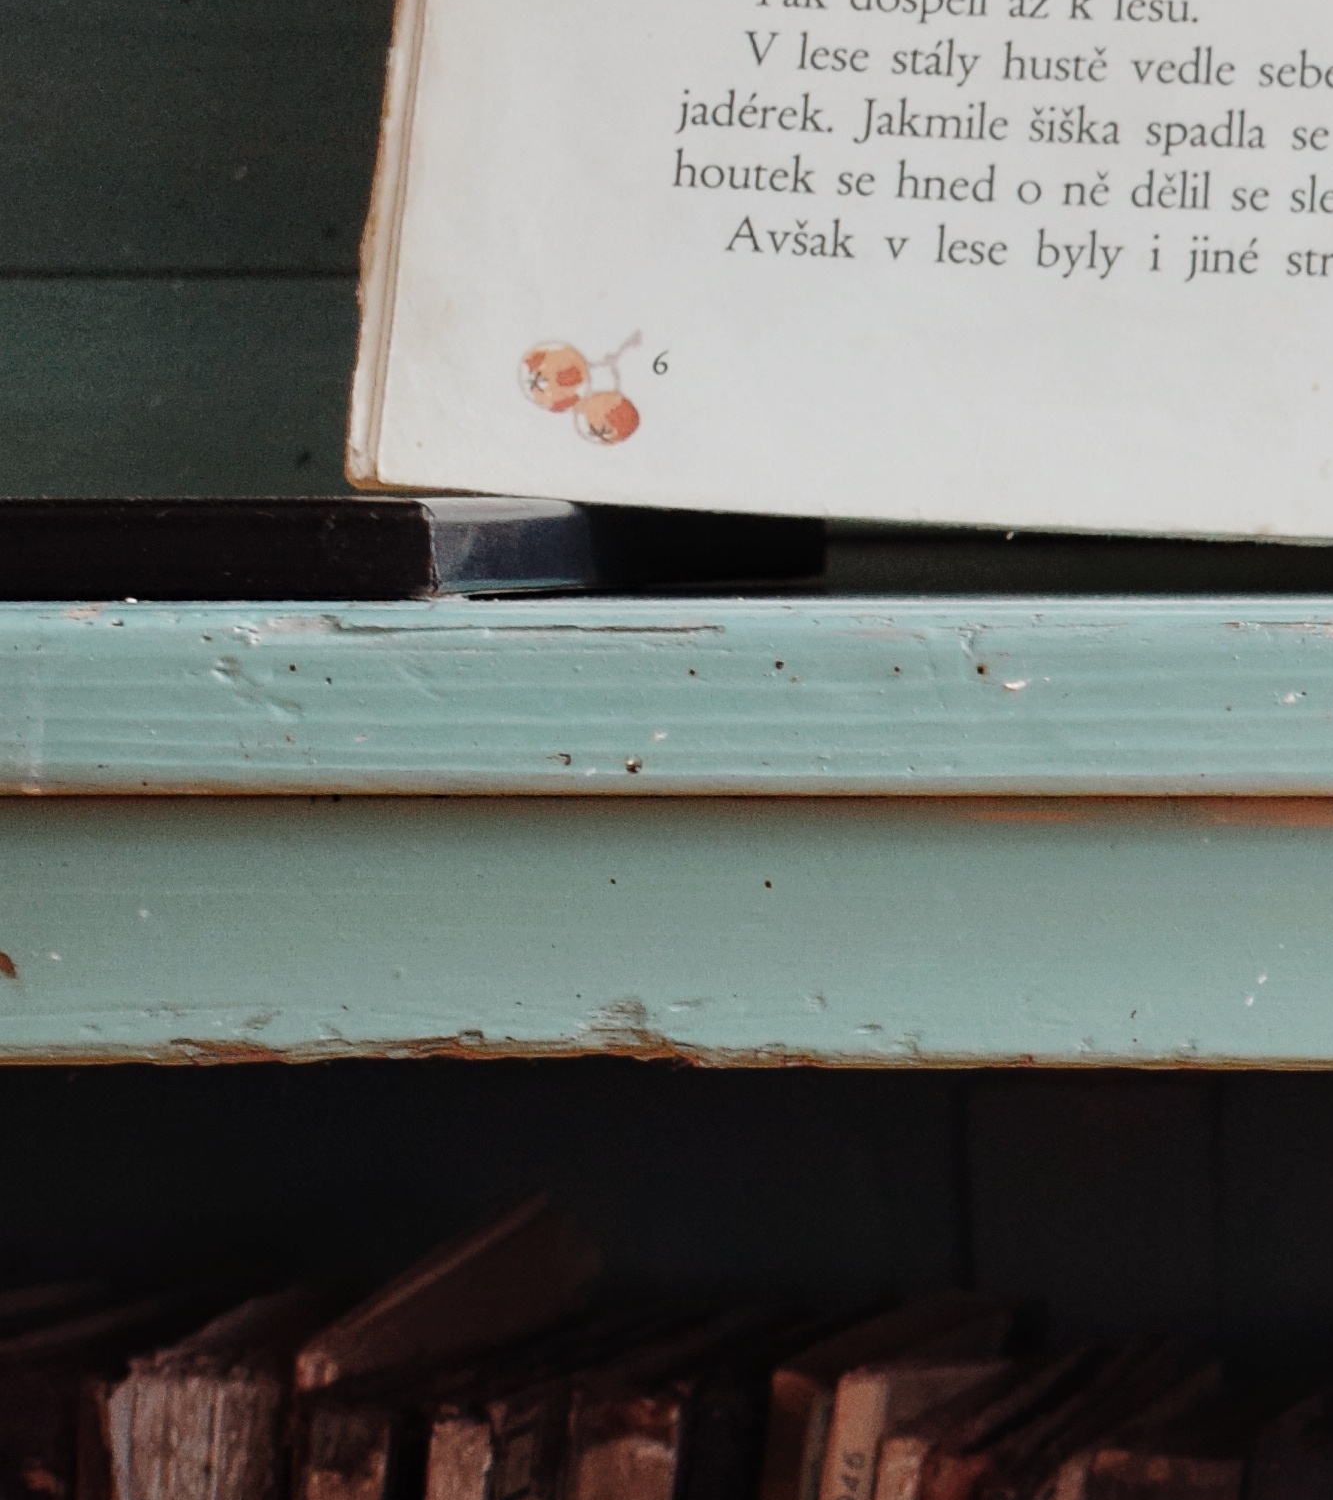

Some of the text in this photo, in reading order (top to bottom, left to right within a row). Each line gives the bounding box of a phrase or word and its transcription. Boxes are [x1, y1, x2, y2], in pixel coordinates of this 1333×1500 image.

[743, 29, 781, 68] V
[796, 30, 870, 73] lese
[890, 37, 982, 88] stály
[1001, 39, 1108, 83] hustě
[1130, 45, 1236, 87] vedle
[675, 88, 834, 135] jadérek.
[852, 96, 1009, 145] Jakmile
[1028, 103, 1120, 146] šiška
[1145, 108, 1266, 157] spadla
[1291, 126, 1330, 152] se
[671, 147, 816, 195] houtek
[836, 171, 876, 197] se
[895, 158, 996, 204] hned
[1015, 179, 1044, 207] o
[1061, 170, 1110, 208] ně
[1130, 168, 1211, 211] dělil
[1230, 187, 1270, 213] se
[724, 214, 856, 260] Avšak
[882, 235, 911, 262] v
[934, 223, 1009, 267] lese
[1036, 227, 1125, 281] byly
[1148, 232, 1162, 273] i
[1184, 235, 1260, 283] jiné
[652, 349, 669, 376] 6
